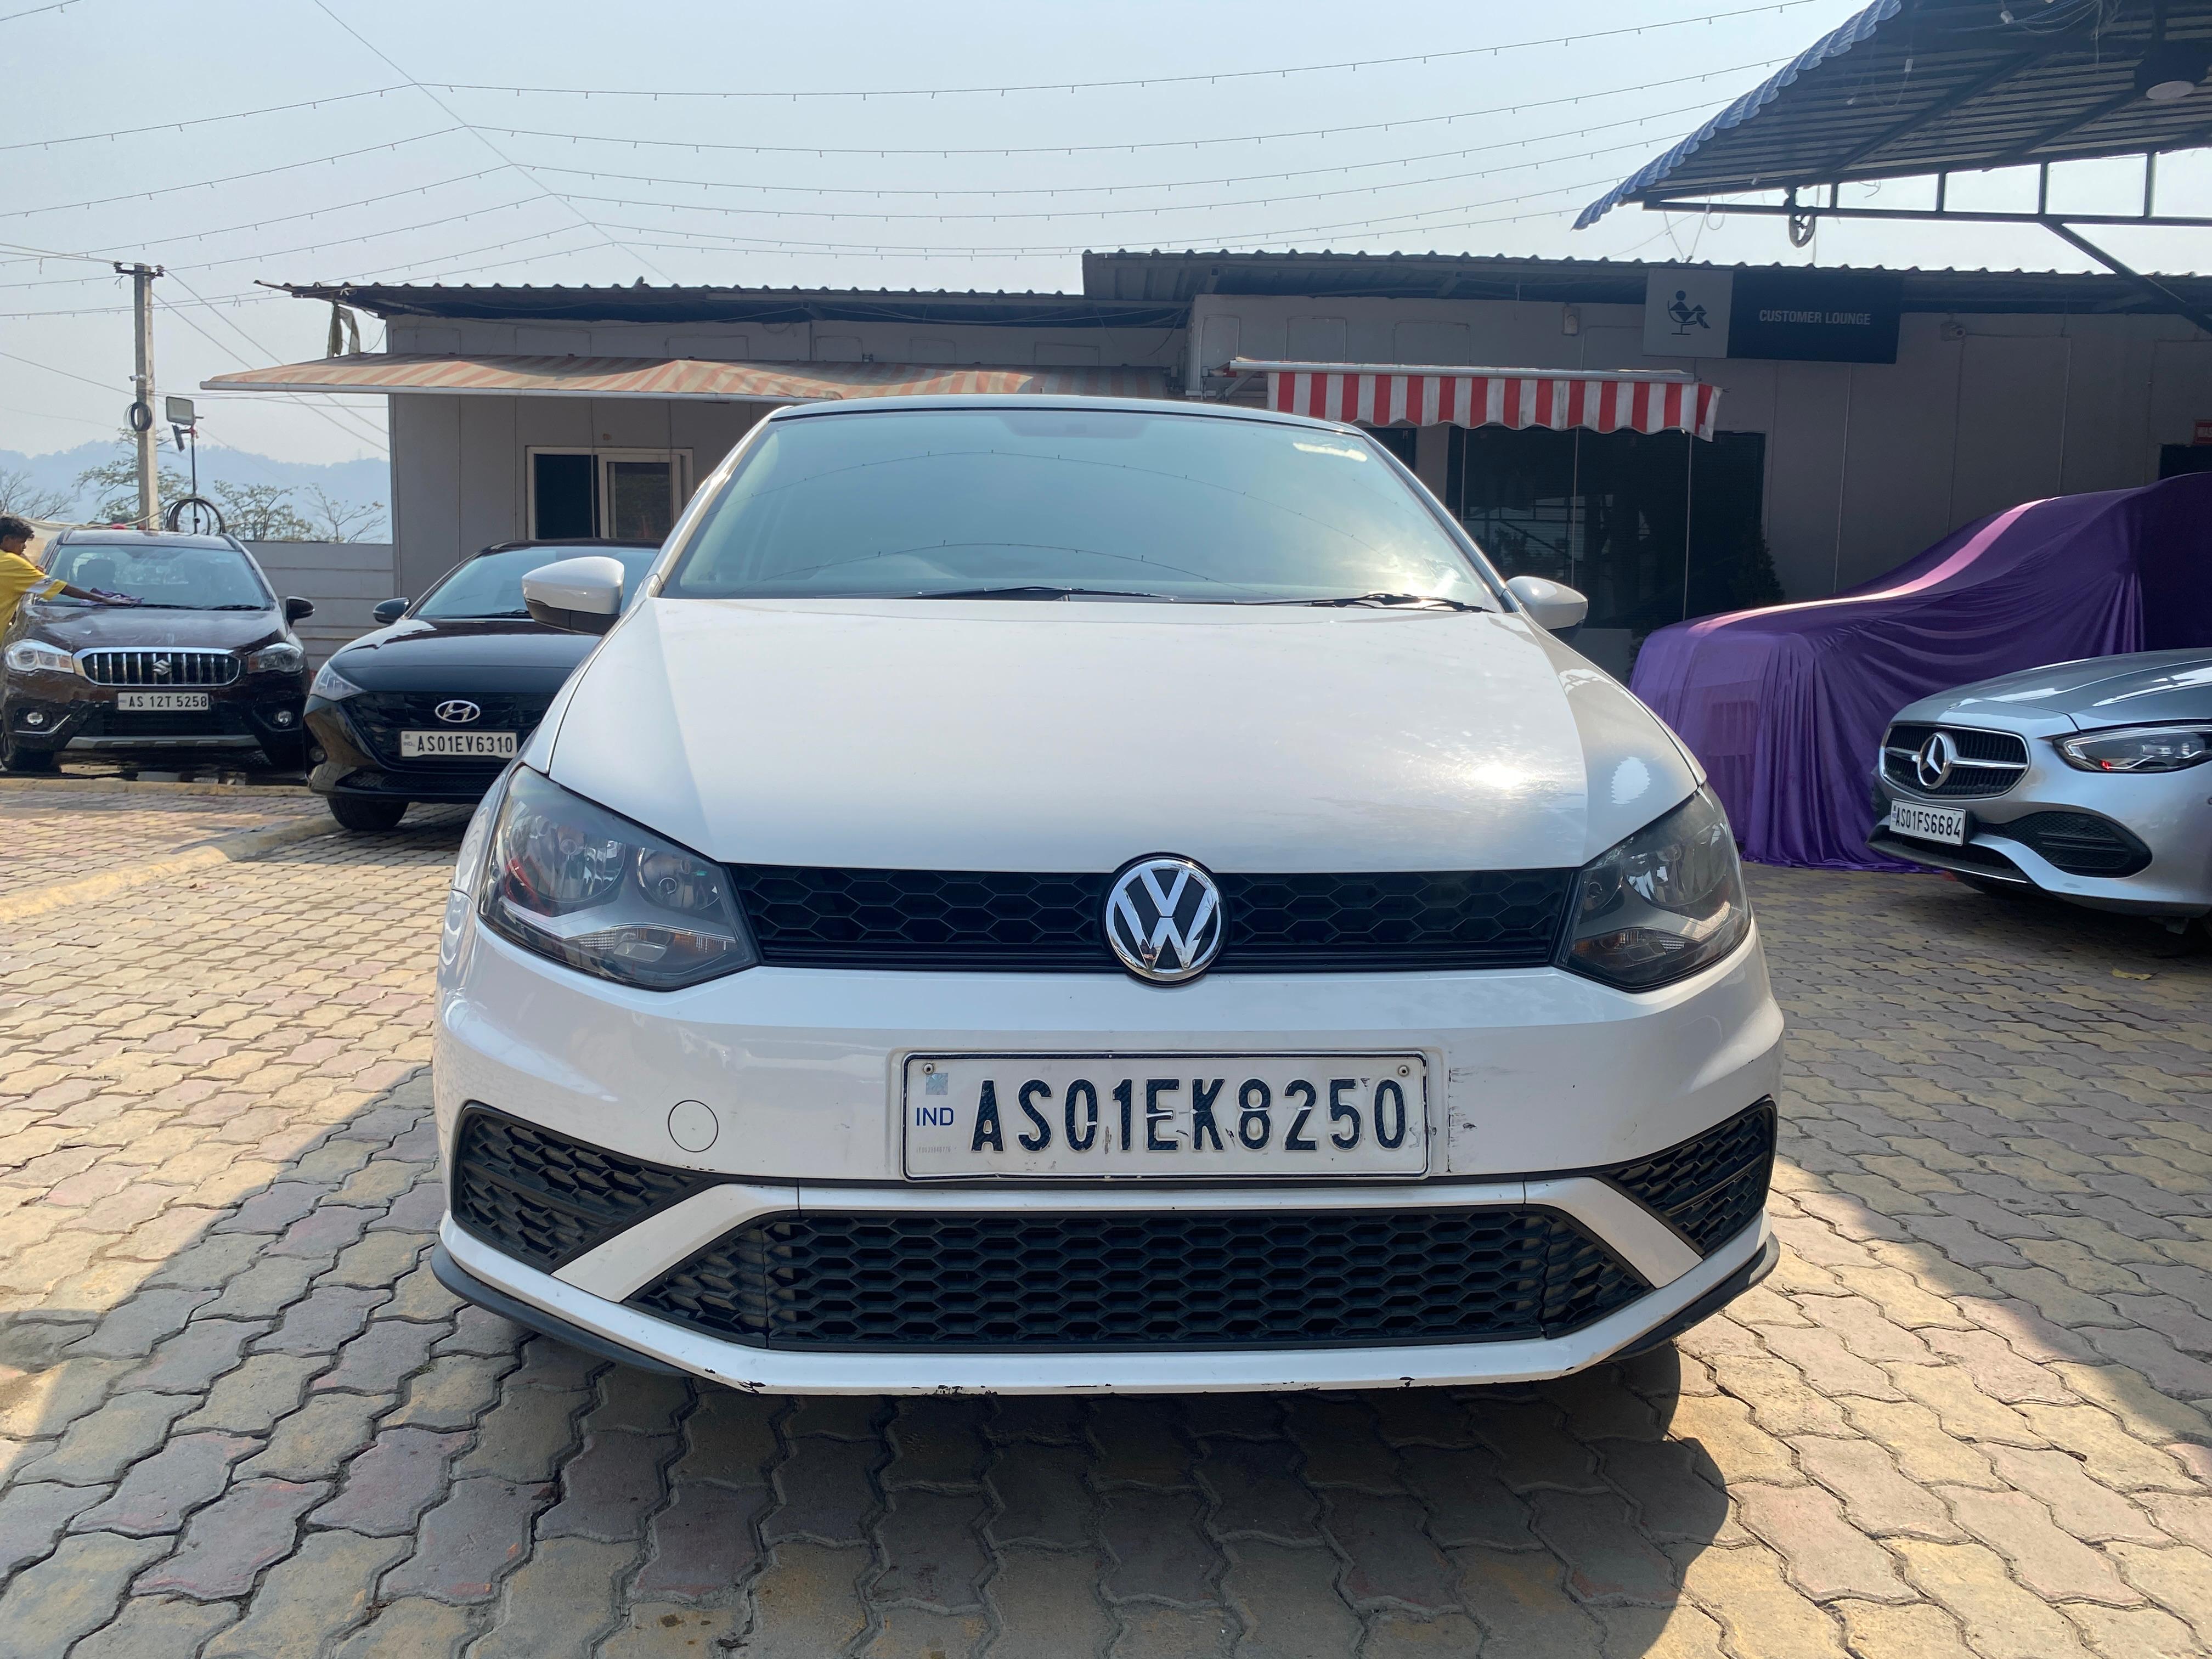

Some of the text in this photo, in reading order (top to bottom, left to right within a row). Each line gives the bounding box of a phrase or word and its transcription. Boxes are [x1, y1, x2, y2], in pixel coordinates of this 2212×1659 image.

[1759, 309, 1871, 325] CUSTOMER LOUNGE
[129, 696, 207, 707] AS 12T 5258
[417, 736, 513, 753] AS01EV6310
[1896, 807, 1962, 838] AS01FS6684
[916, 1107, 953, 1126] IND
[970, 1077, 1407, 1153] AS01EK8250
